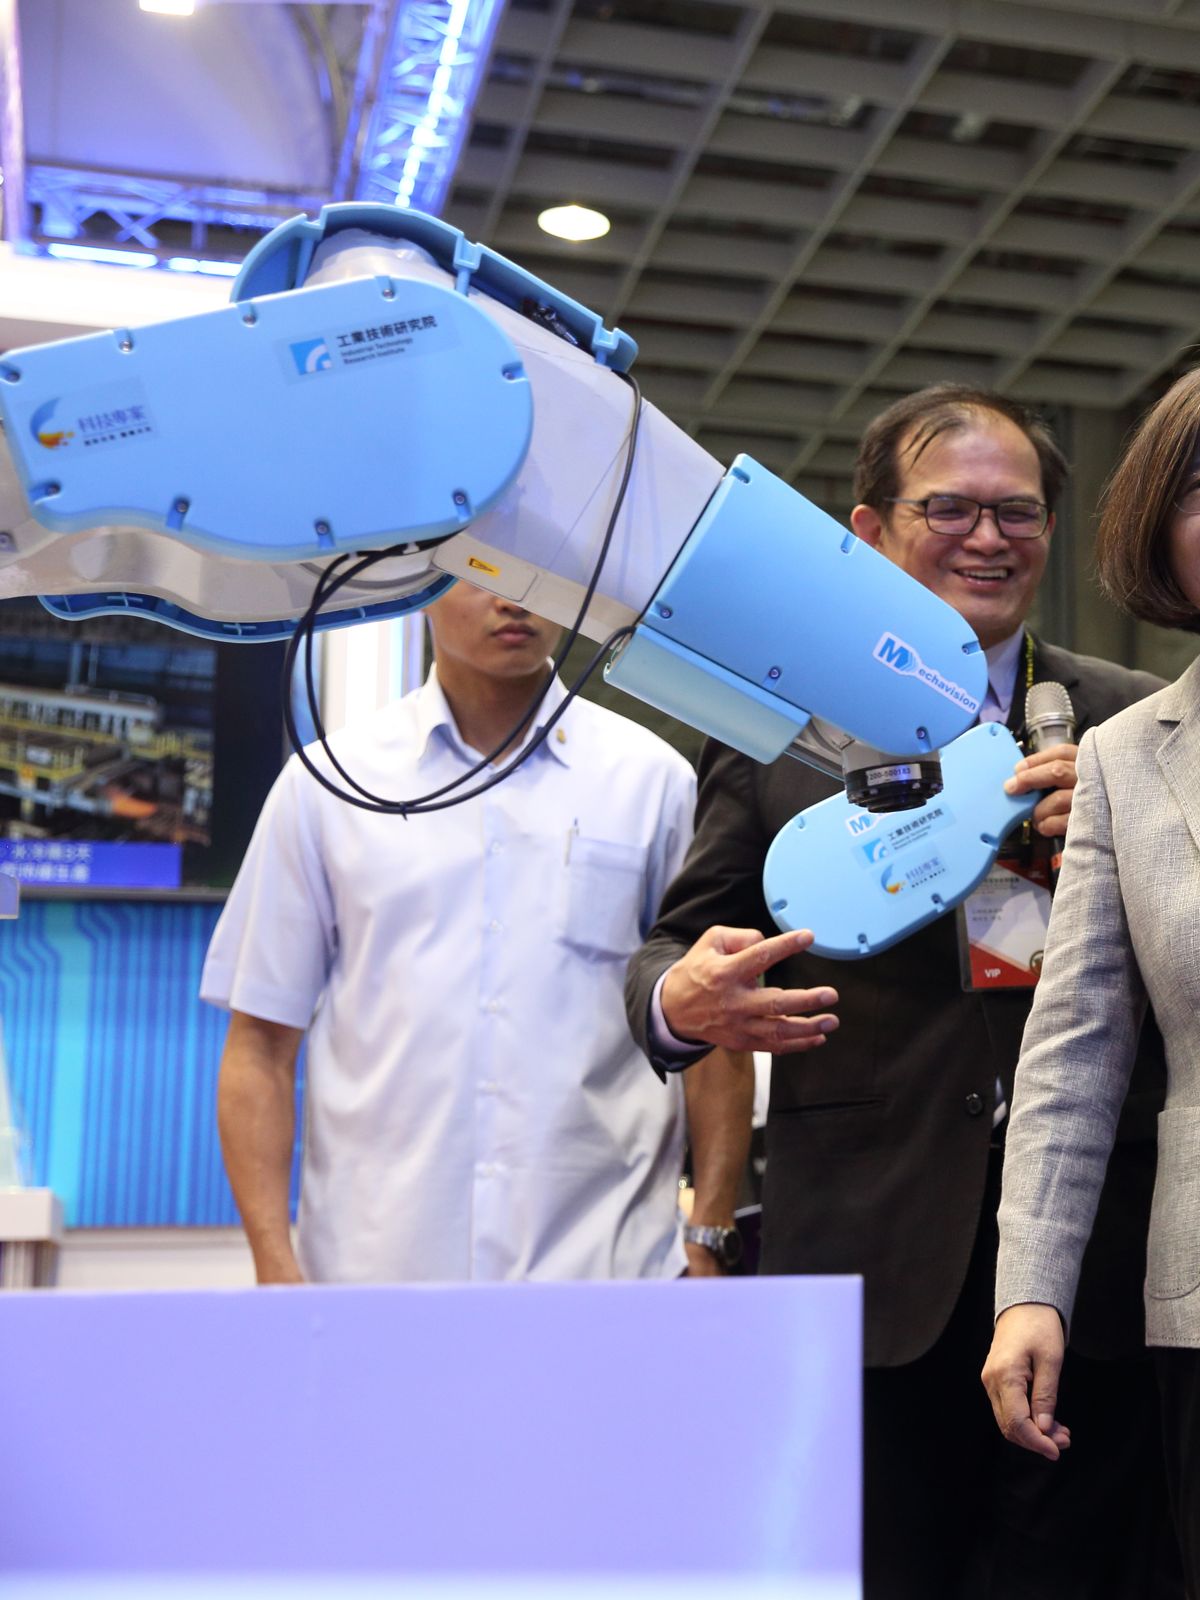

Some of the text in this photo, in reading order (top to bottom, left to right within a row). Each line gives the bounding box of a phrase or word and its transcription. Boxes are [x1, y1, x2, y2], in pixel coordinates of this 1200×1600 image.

[336, 314, 438, 348] 工業技術研究院
[984, 968, 1001, 979] VIP
